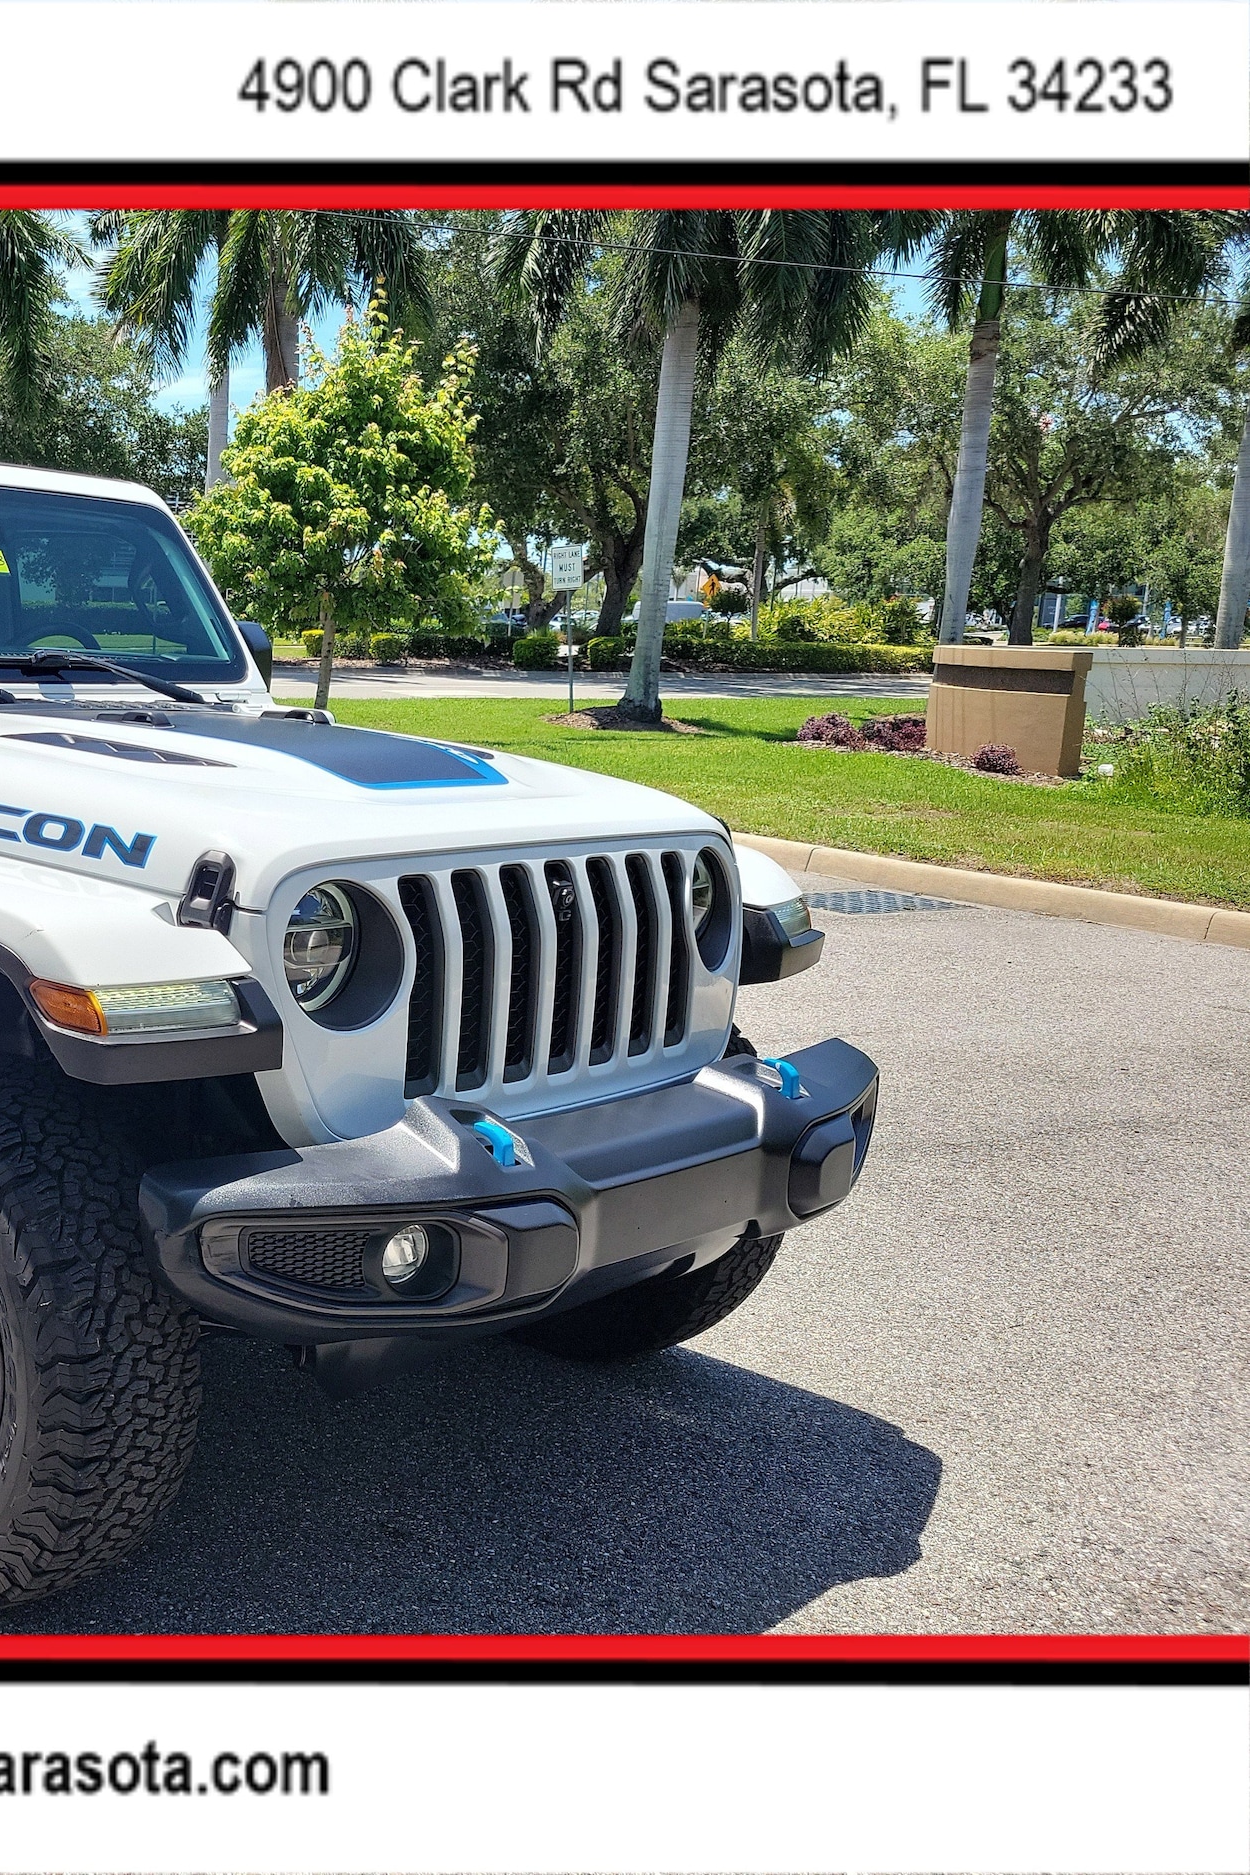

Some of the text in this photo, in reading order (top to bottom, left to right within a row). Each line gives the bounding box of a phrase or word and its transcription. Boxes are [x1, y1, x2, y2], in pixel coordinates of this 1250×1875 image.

[568, 550, 581, 558] LANE
[559, 563, 575, 571] MUST
[567, 575, 581, 583] RIGHT
